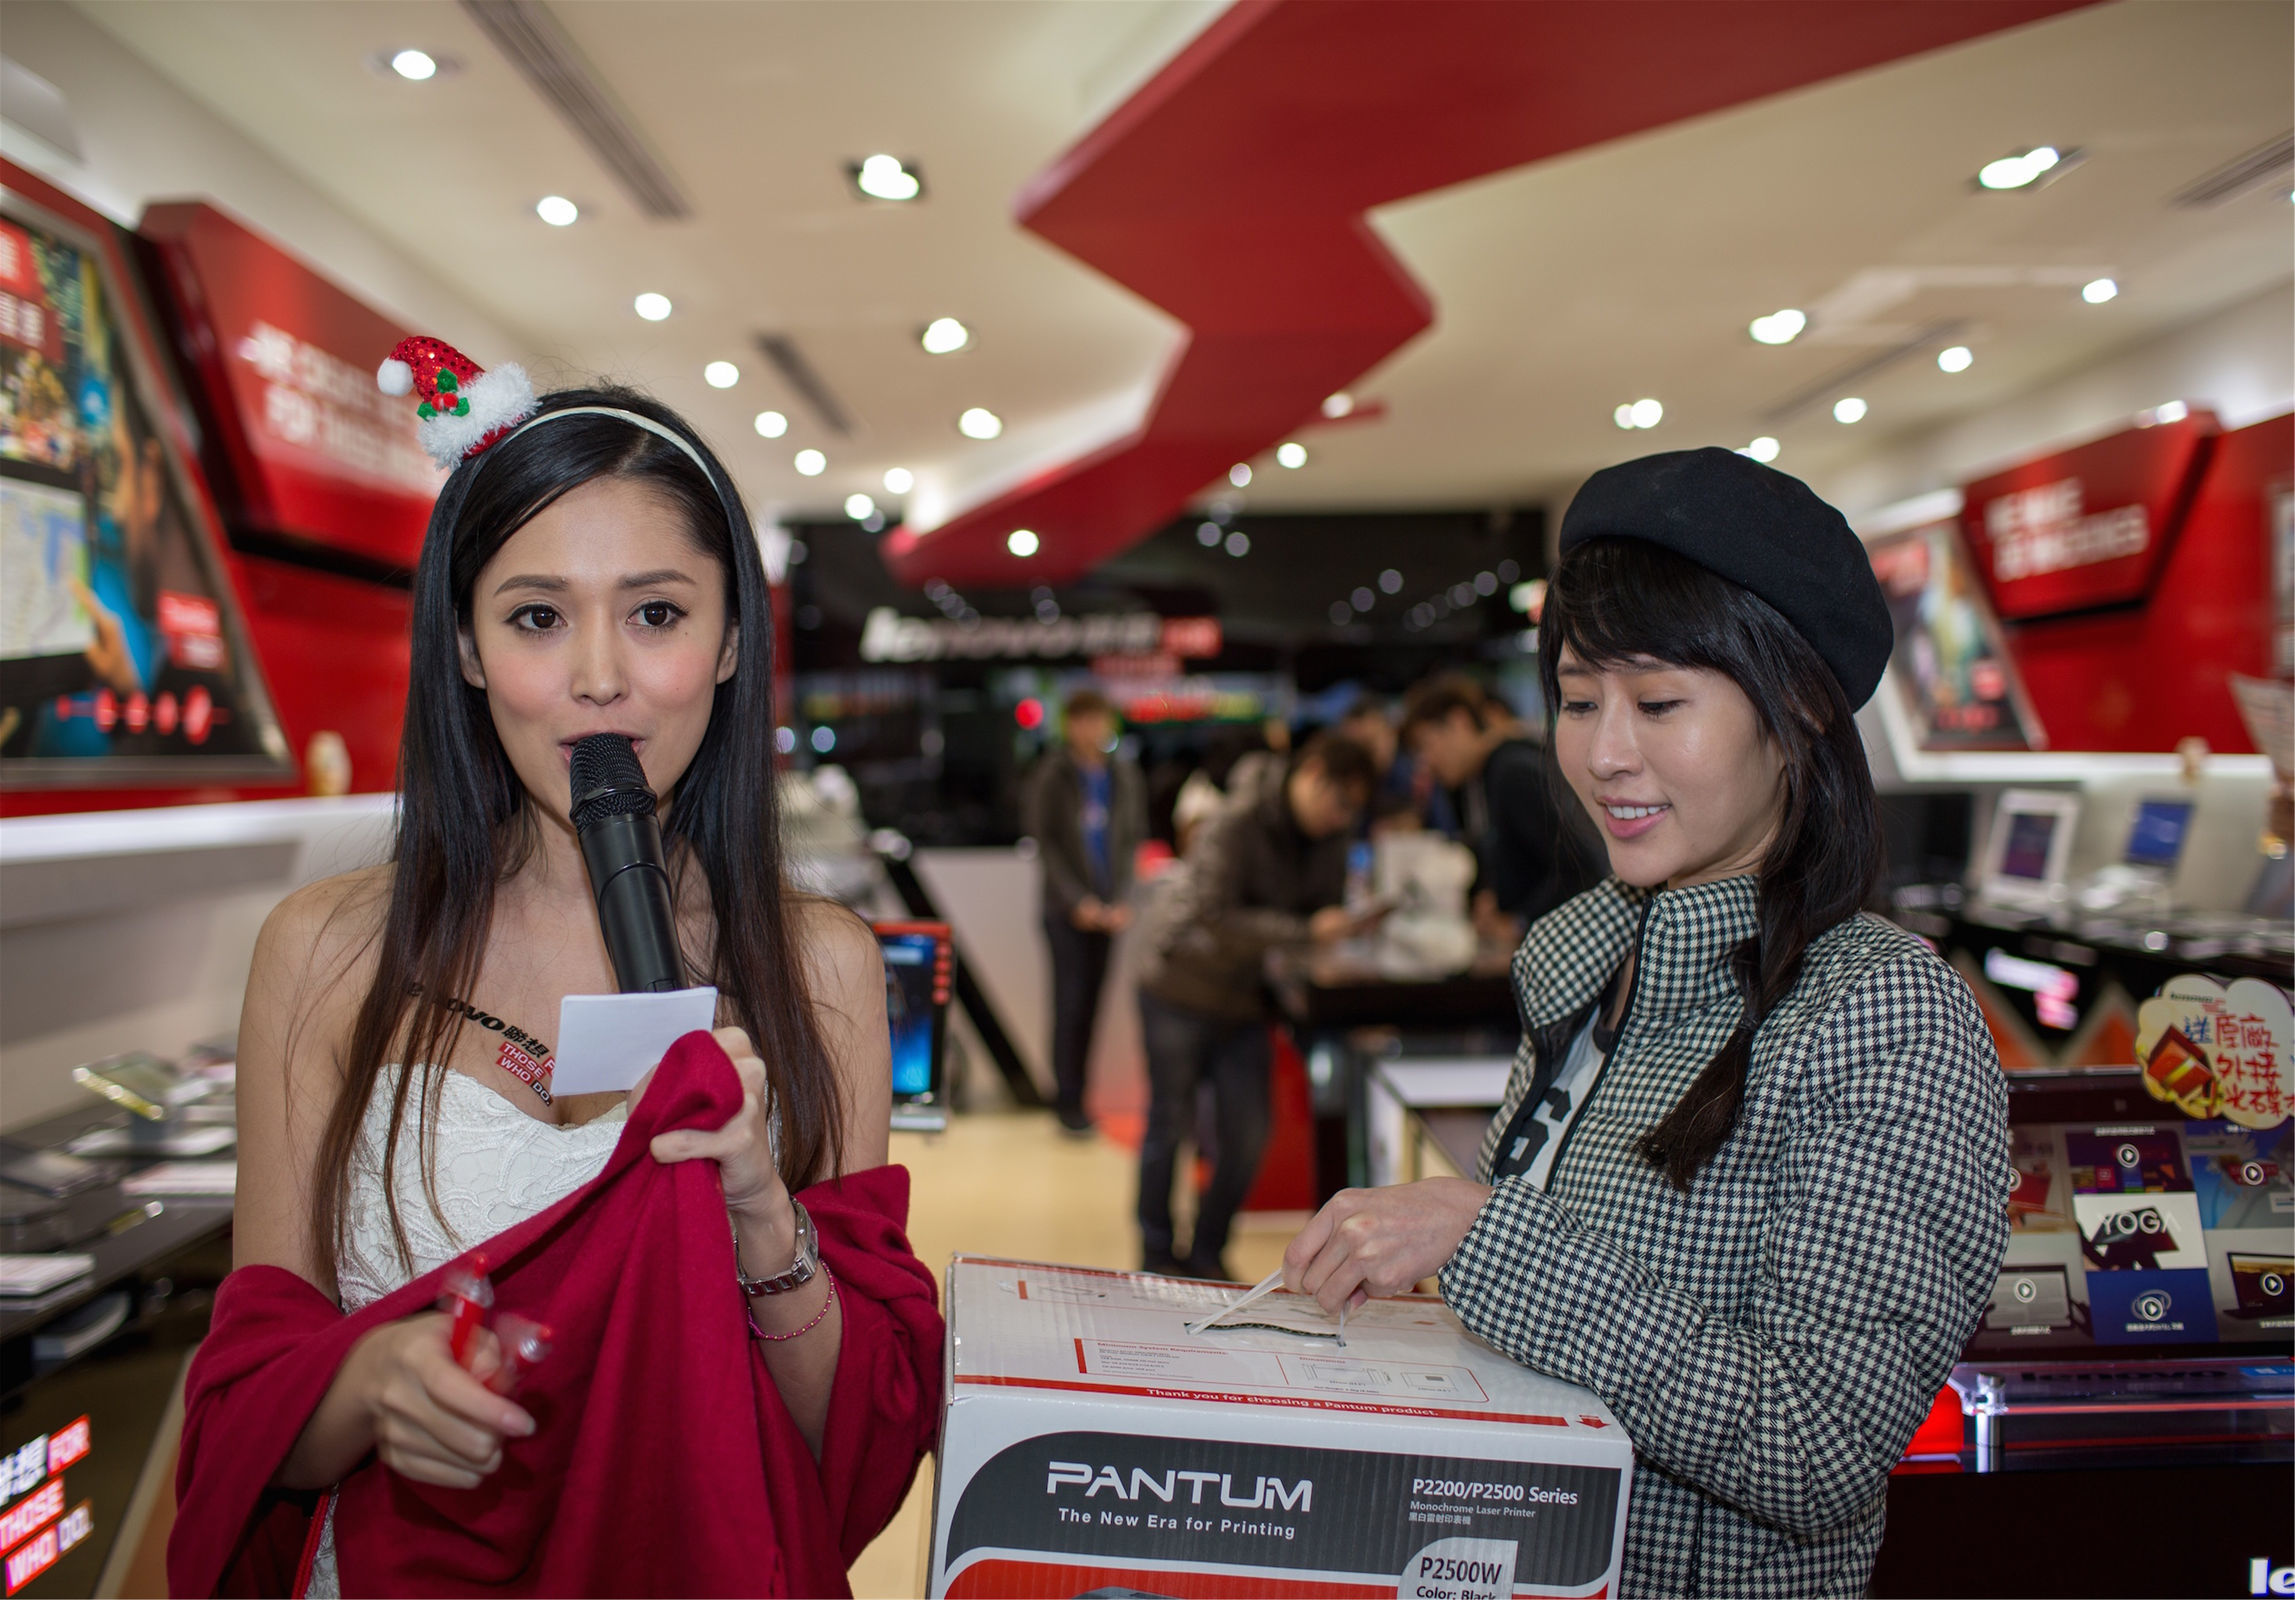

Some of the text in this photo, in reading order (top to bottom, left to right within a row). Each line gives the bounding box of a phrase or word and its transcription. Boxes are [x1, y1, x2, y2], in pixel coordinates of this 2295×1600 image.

[503, 1043, 545, 1078] THOSE
[500, 1056, 532, 1082] WHO
[532, 1081, 551, 1105] DO.
[1146, 1388, 1190, 1398] Thank
[1193, 1393, 1219, 1402] you
[1222, 1394, 1245, 1402] for
[1247, 1395, 1310, 1407] choosing
[1325, 1401, 1378, 1412] Pantum
[1381, 1405, 1439, 1417] product.
[1047, 1461, 1313, 1512] PANTUM
[1412, 1478, 1578, 1505] P2200/P2500 Series
[1058, 1507, 1296, 1540] The New Era for Printing
[1410, 1501, 1536, 1518] Monochrome Laser Printer
[8, 1533, 56, 1588] WHO
[1419, 1556, 1502, 1585] P2500W
[1416, 1585, 1457, 1600] Color:
